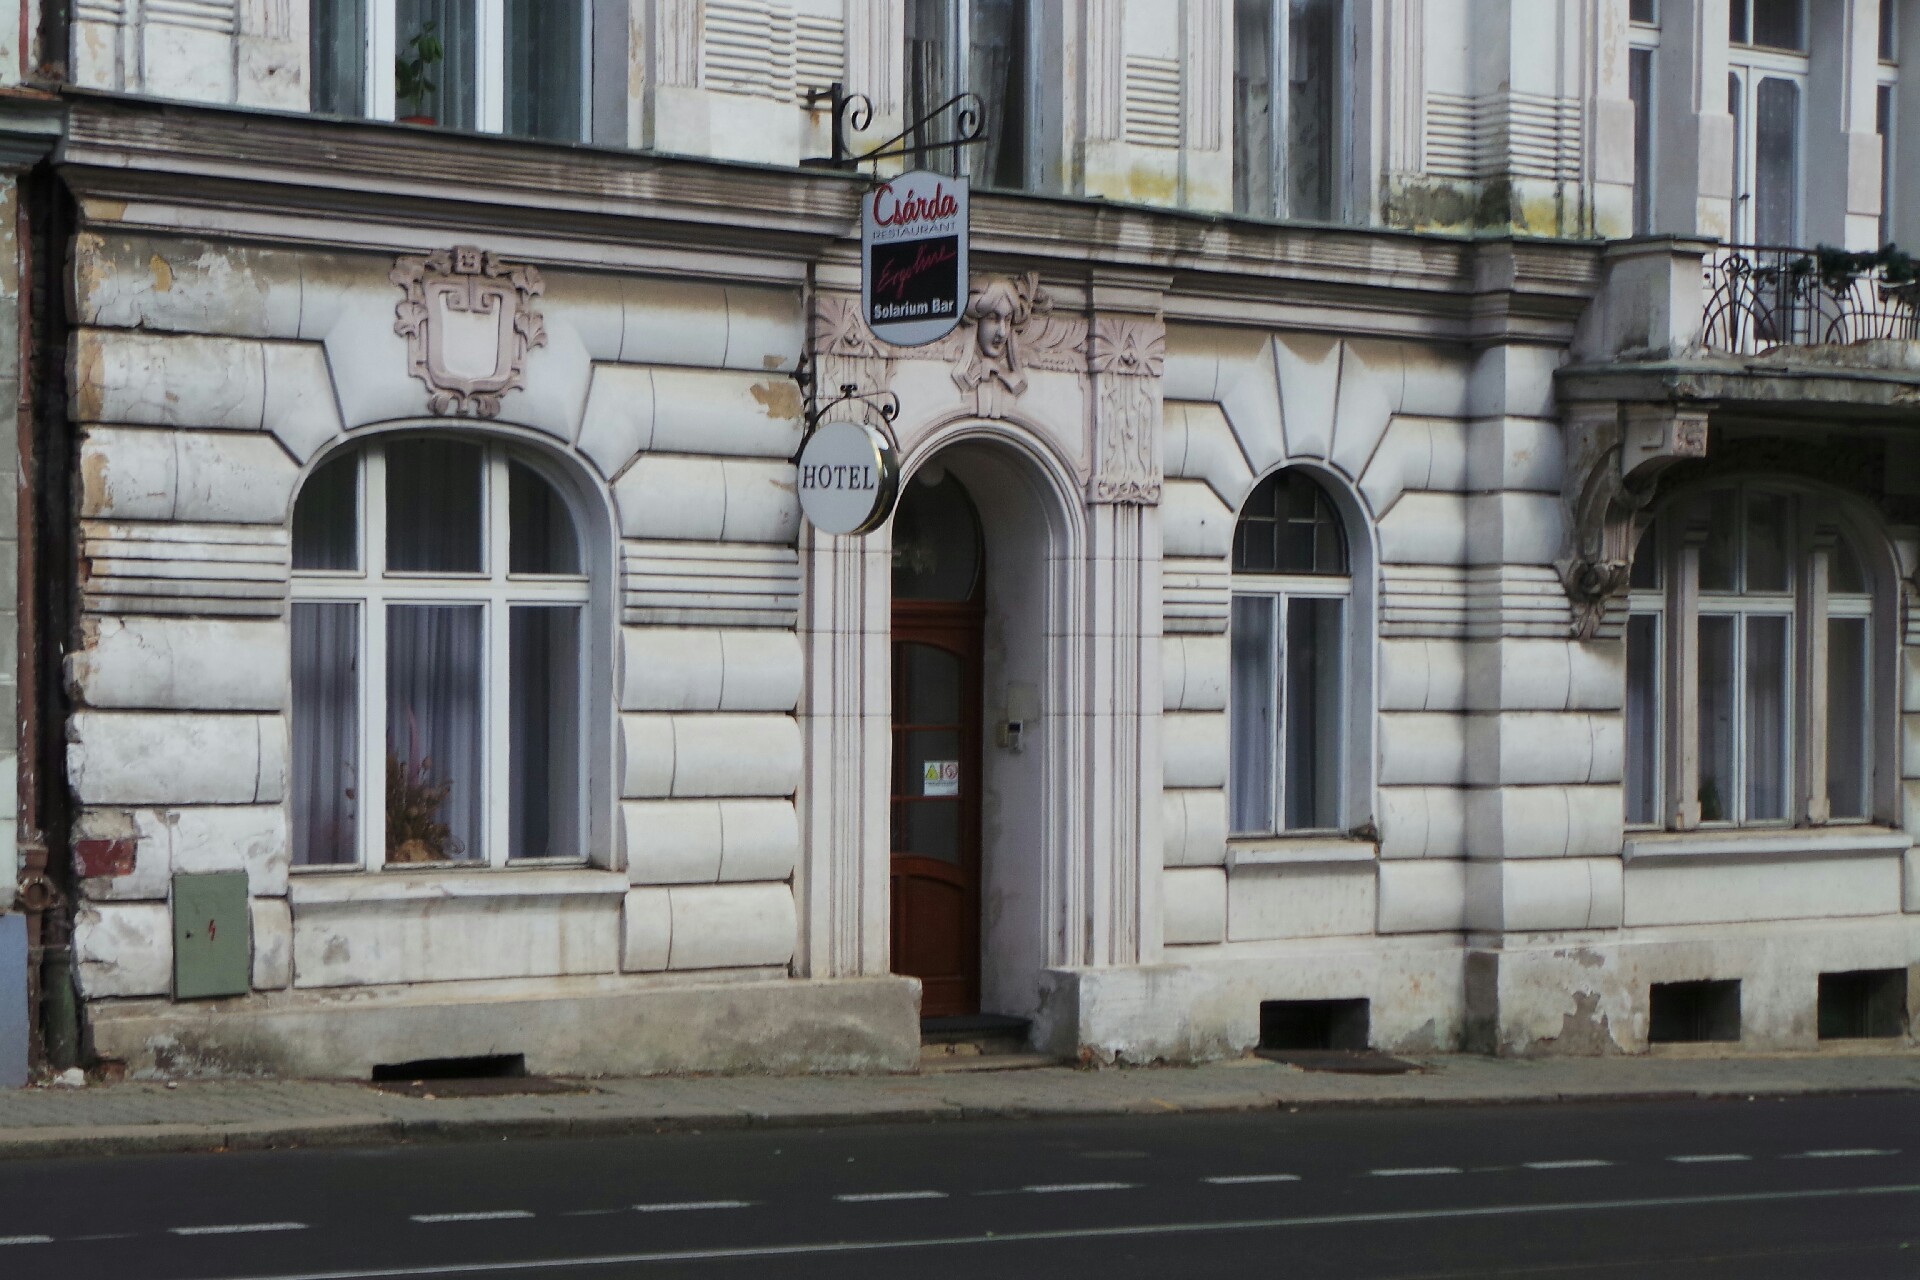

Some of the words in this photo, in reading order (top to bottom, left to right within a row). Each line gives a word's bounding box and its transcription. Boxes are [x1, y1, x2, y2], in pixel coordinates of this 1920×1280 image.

[873, 182, 958, 227] Csárda
[873, 222, 955, 239] RESTAURANT
[874, 300, 928, 319] Solarium
[932, 297, 954, 314] Bar
[802, 464, 874, 490] HOTEL
